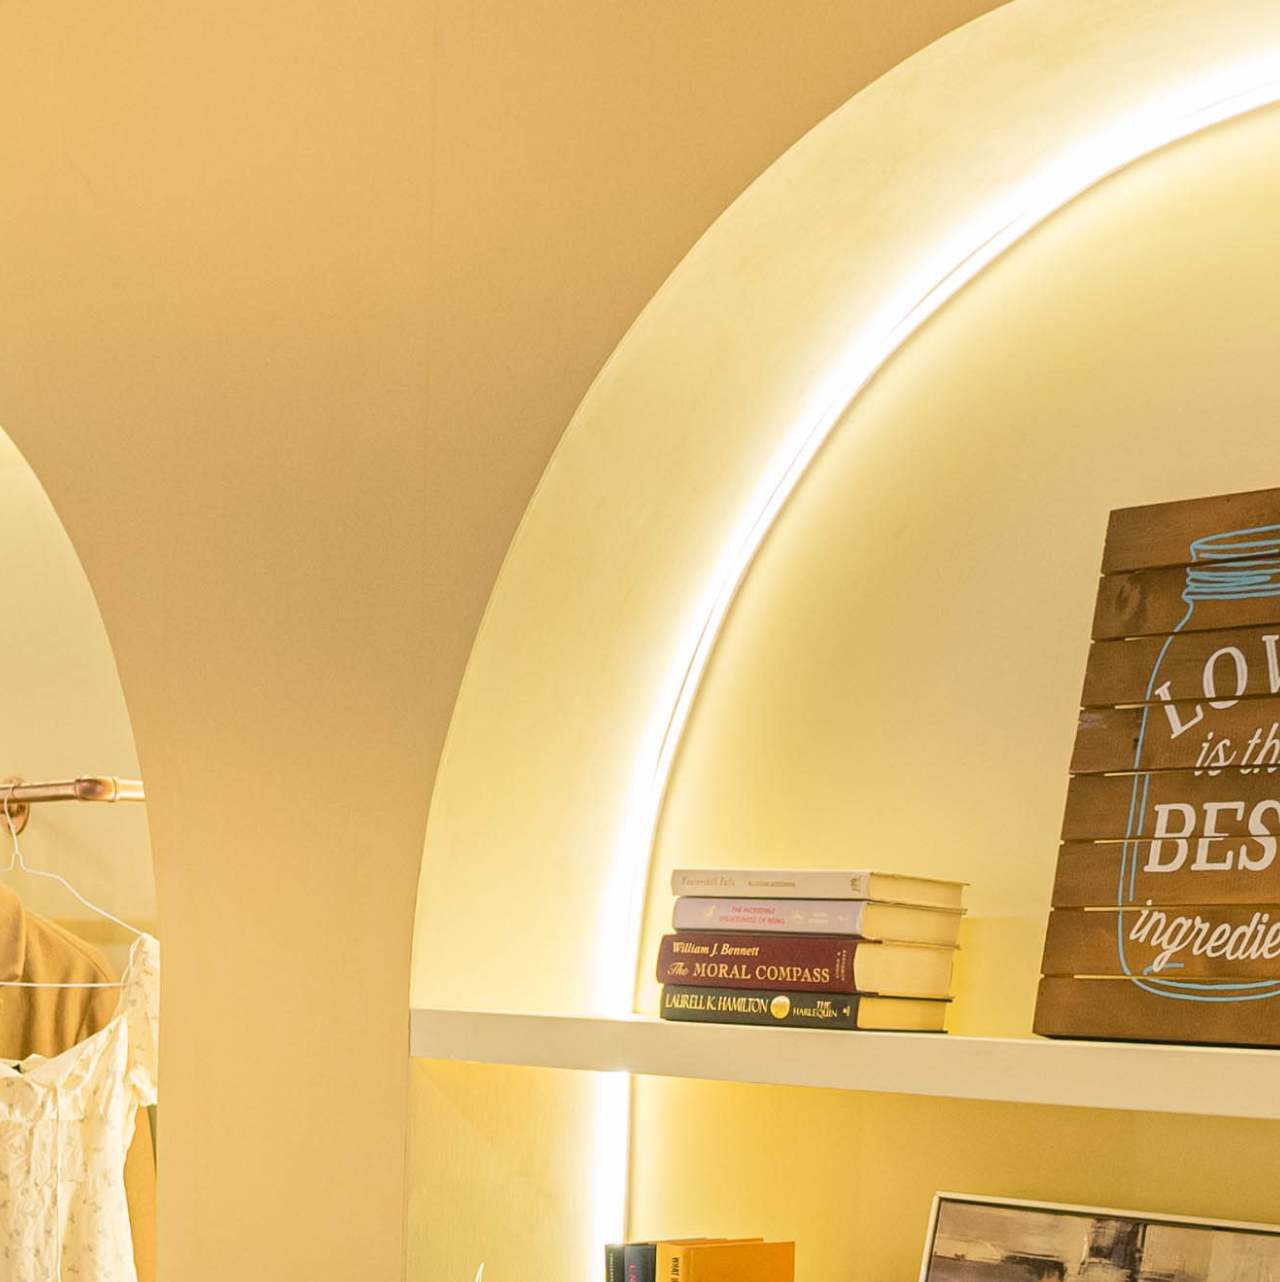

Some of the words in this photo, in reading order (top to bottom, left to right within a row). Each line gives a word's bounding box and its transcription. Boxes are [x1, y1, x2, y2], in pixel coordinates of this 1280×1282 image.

[1193, 731, 1237, 776] is
[672, 941, 709, 955] William
[709, 944, 719, 957] J.
[721, 943, 760, 957] Bennett
[667, 961, 689, 977] The
[692, 962, 752, 980] MORAL
[755, 965, 830, 983] COMPASS
[665, 993, 705, 1010] LAURELL
[717, 994, 770, 1014] HAMILTON
[792, 1007, 838, 1019] HARLEQUIN
[816, 1000, 832, 1009] THE
[672, 1256, 680, 1277] WHAT
